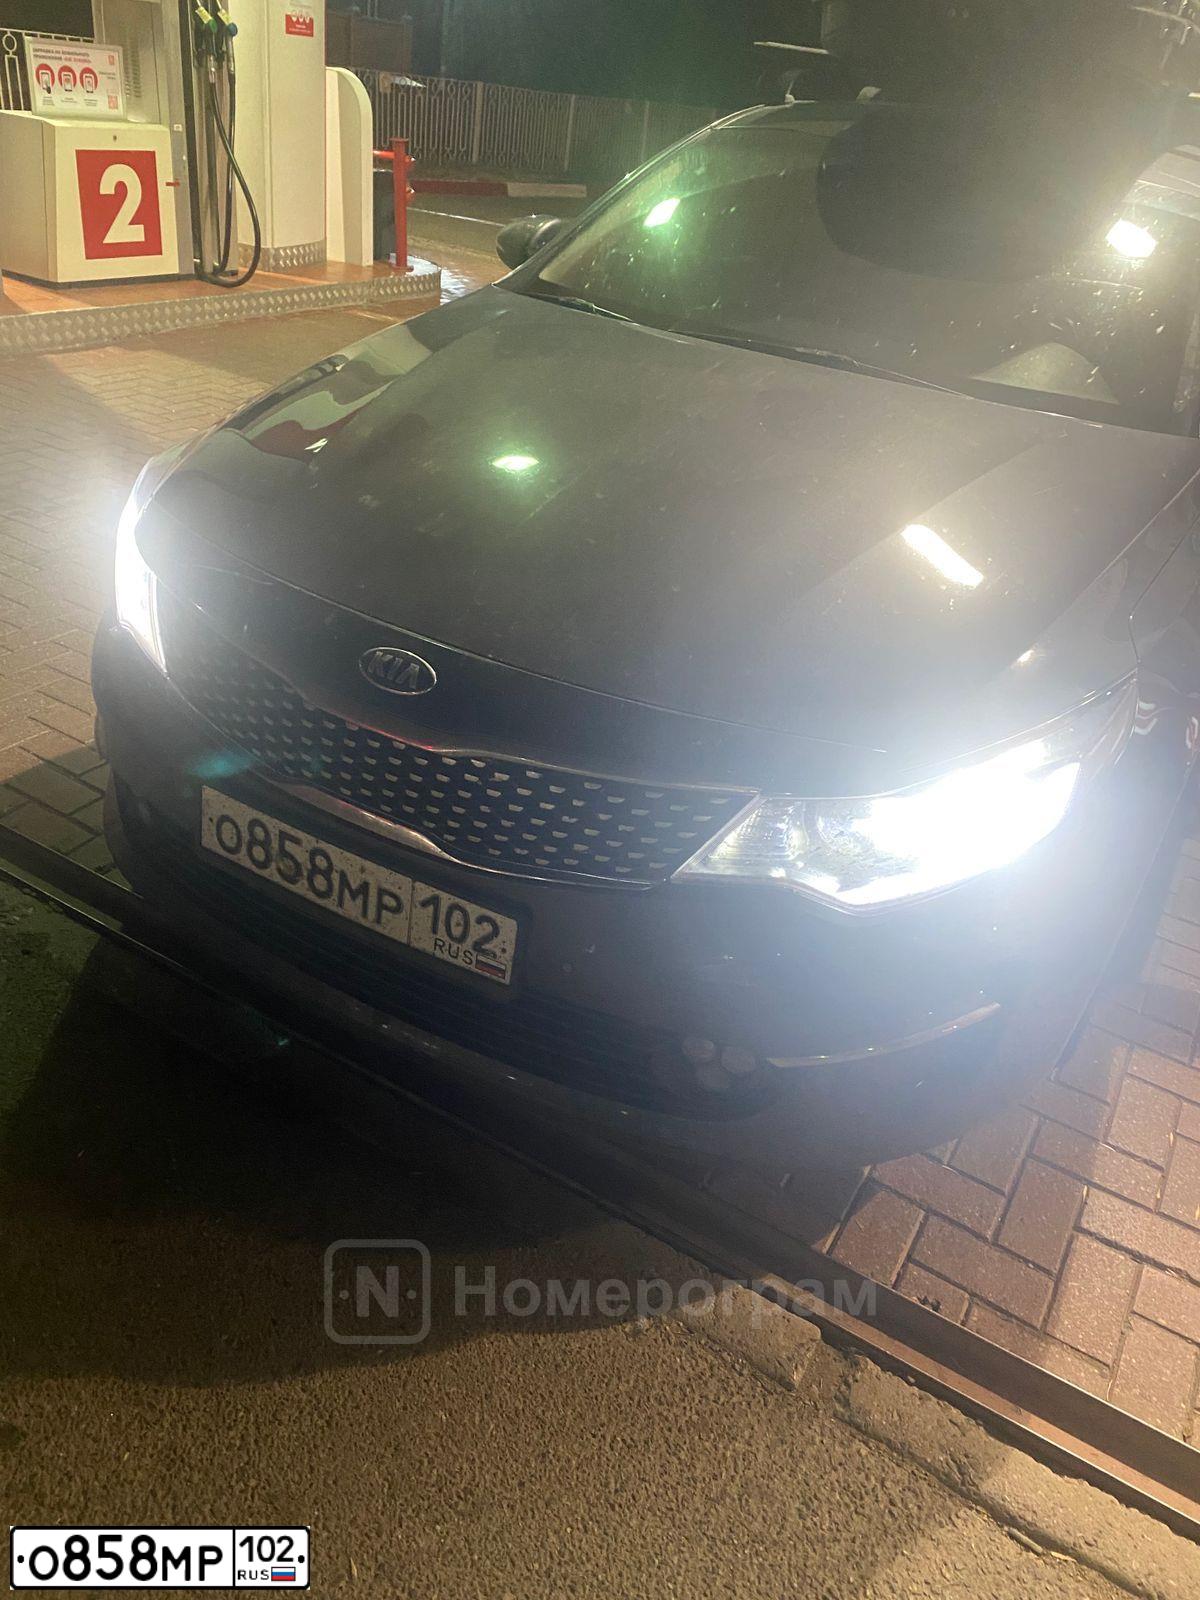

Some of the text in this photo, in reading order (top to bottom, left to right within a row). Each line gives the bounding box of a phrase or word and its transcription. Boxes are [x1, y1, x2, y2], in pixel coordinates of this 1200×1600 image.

[99, 163, 146, 244] 2
[368, 651, 420, 690] KIA
[420, 893, 501, 958] 102
[434, 938, 475, 966] RUS
